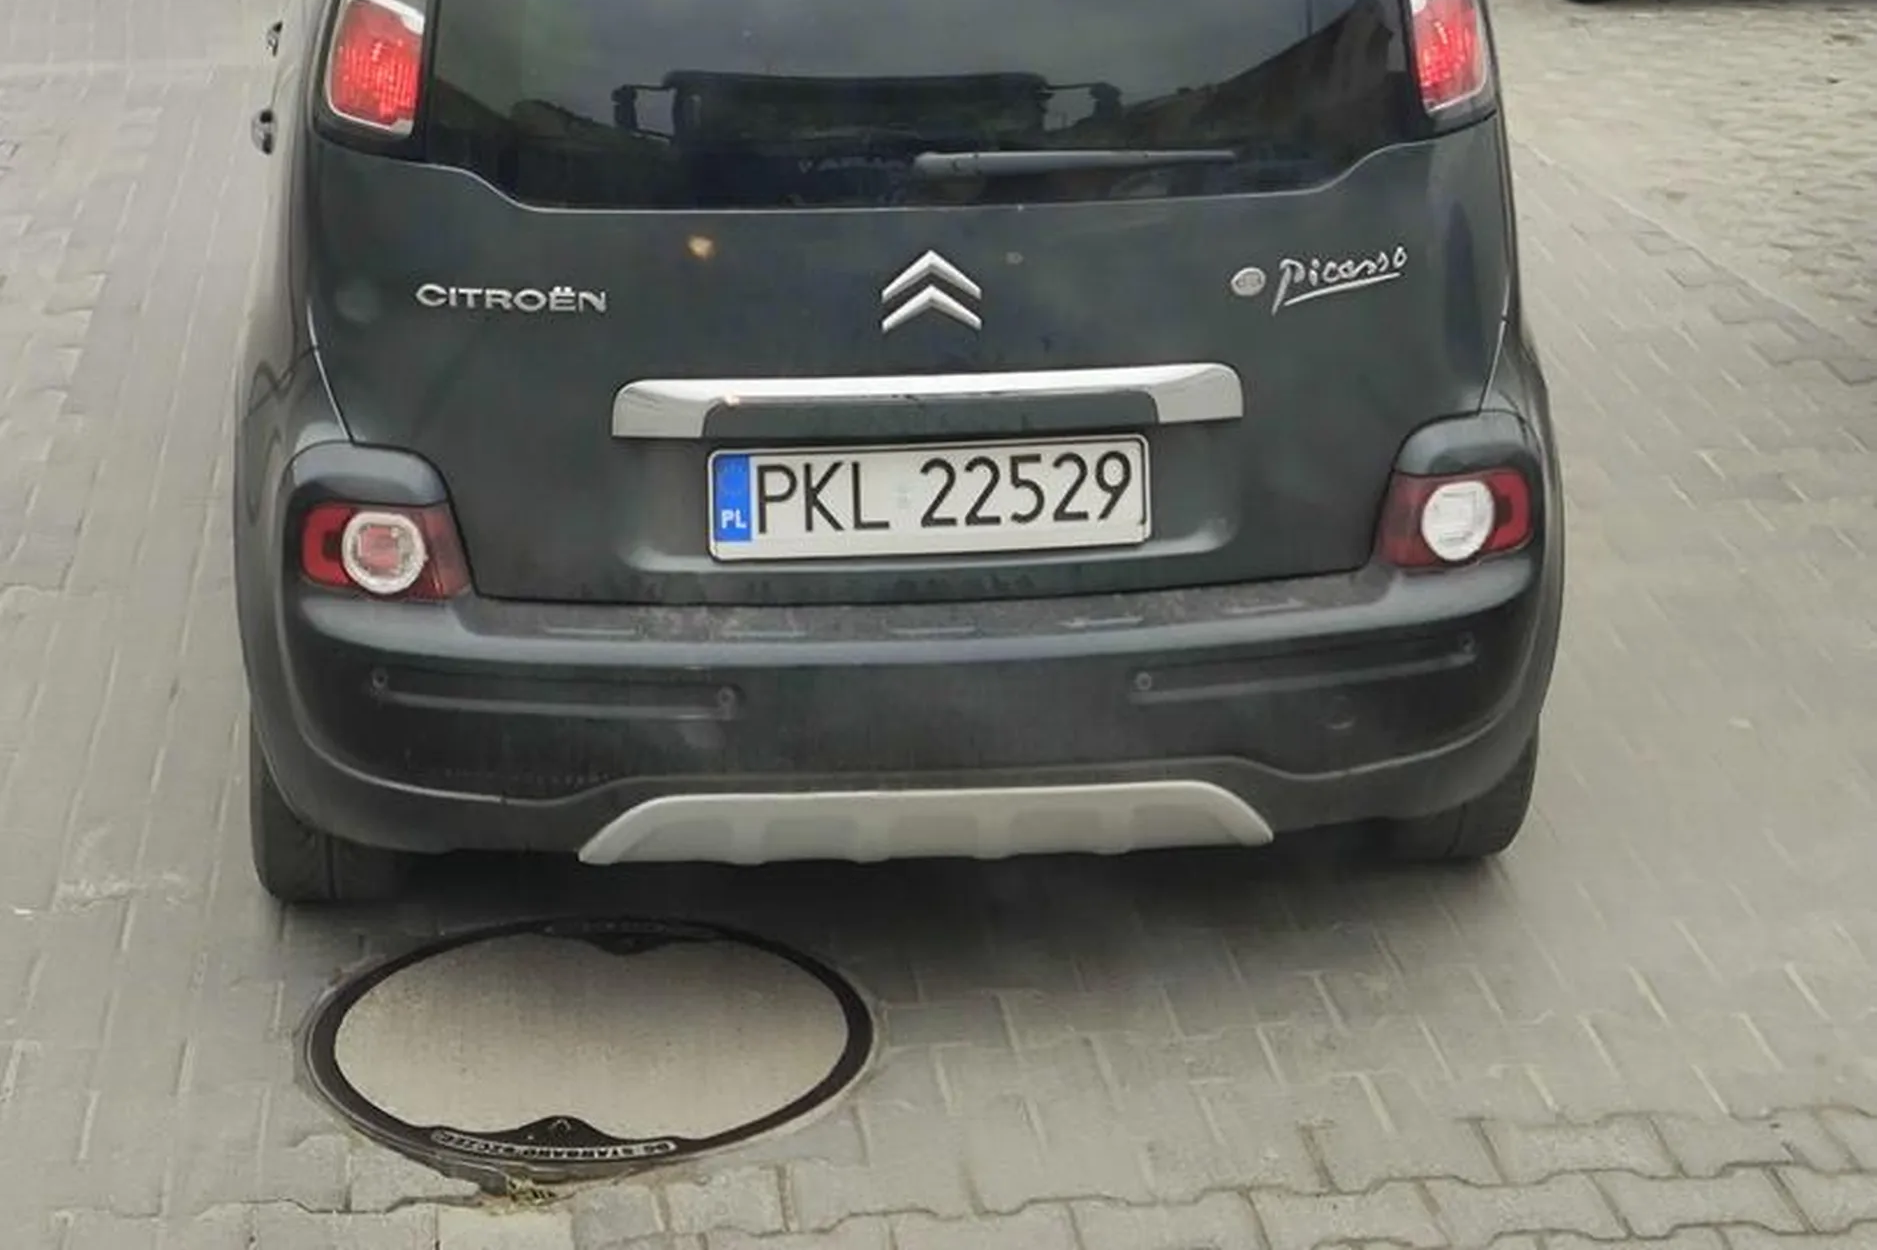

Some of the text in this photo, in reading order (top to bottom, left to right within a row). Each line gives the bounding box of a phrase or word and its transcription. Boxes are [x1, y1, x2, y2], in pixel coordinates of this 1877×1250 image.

[415, 282, 606, 312] CITROËN
[1270, 246, 1408, 316] Picasso
[755, 450, 1133, 534] PKL 22529
[721, 508, 747, 529] PL
